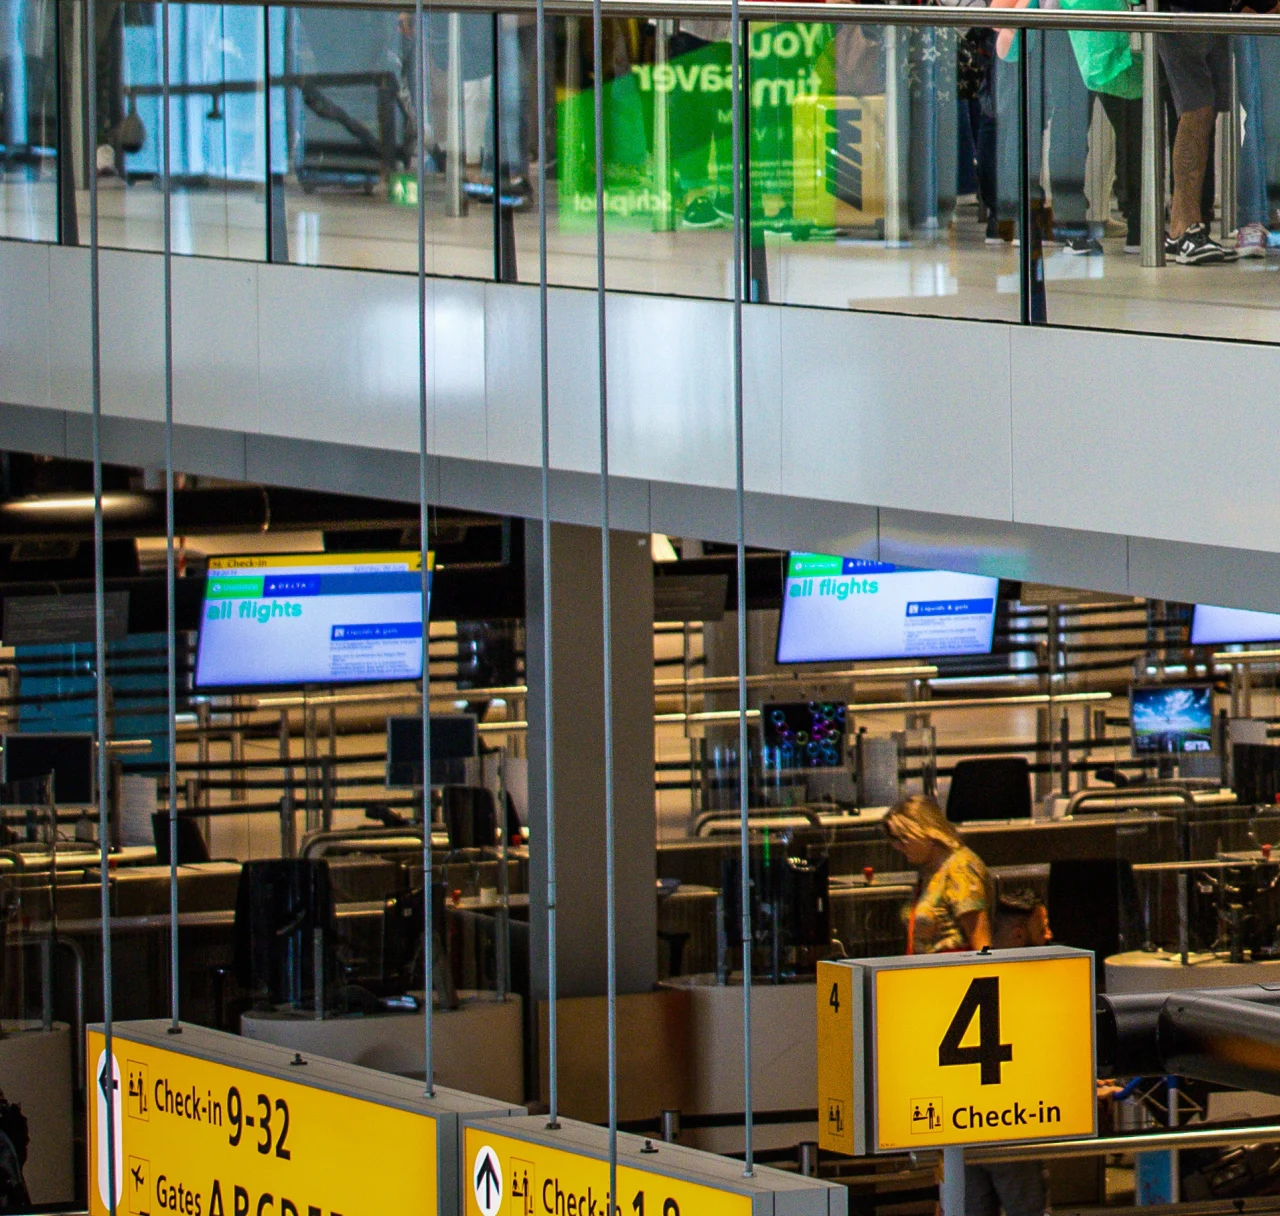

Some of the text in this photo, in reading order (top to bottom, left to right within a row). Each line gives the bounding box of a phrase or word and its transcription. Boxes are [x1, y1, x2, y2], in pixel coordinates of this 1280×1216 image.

[227, 558, 268, 567] Check-in
[789, 577, 879, 601] all flights
[206, 599, 303, 624] all flights
[829, 982, 840, 1014] 4
[938, 975, 1013, 1086] 4
[154, 1078, 291, 1161] Check-in 9-32
[952, 1100, 1061, 1130] Check-in
[156, 1173, 201, 1216] Gates
